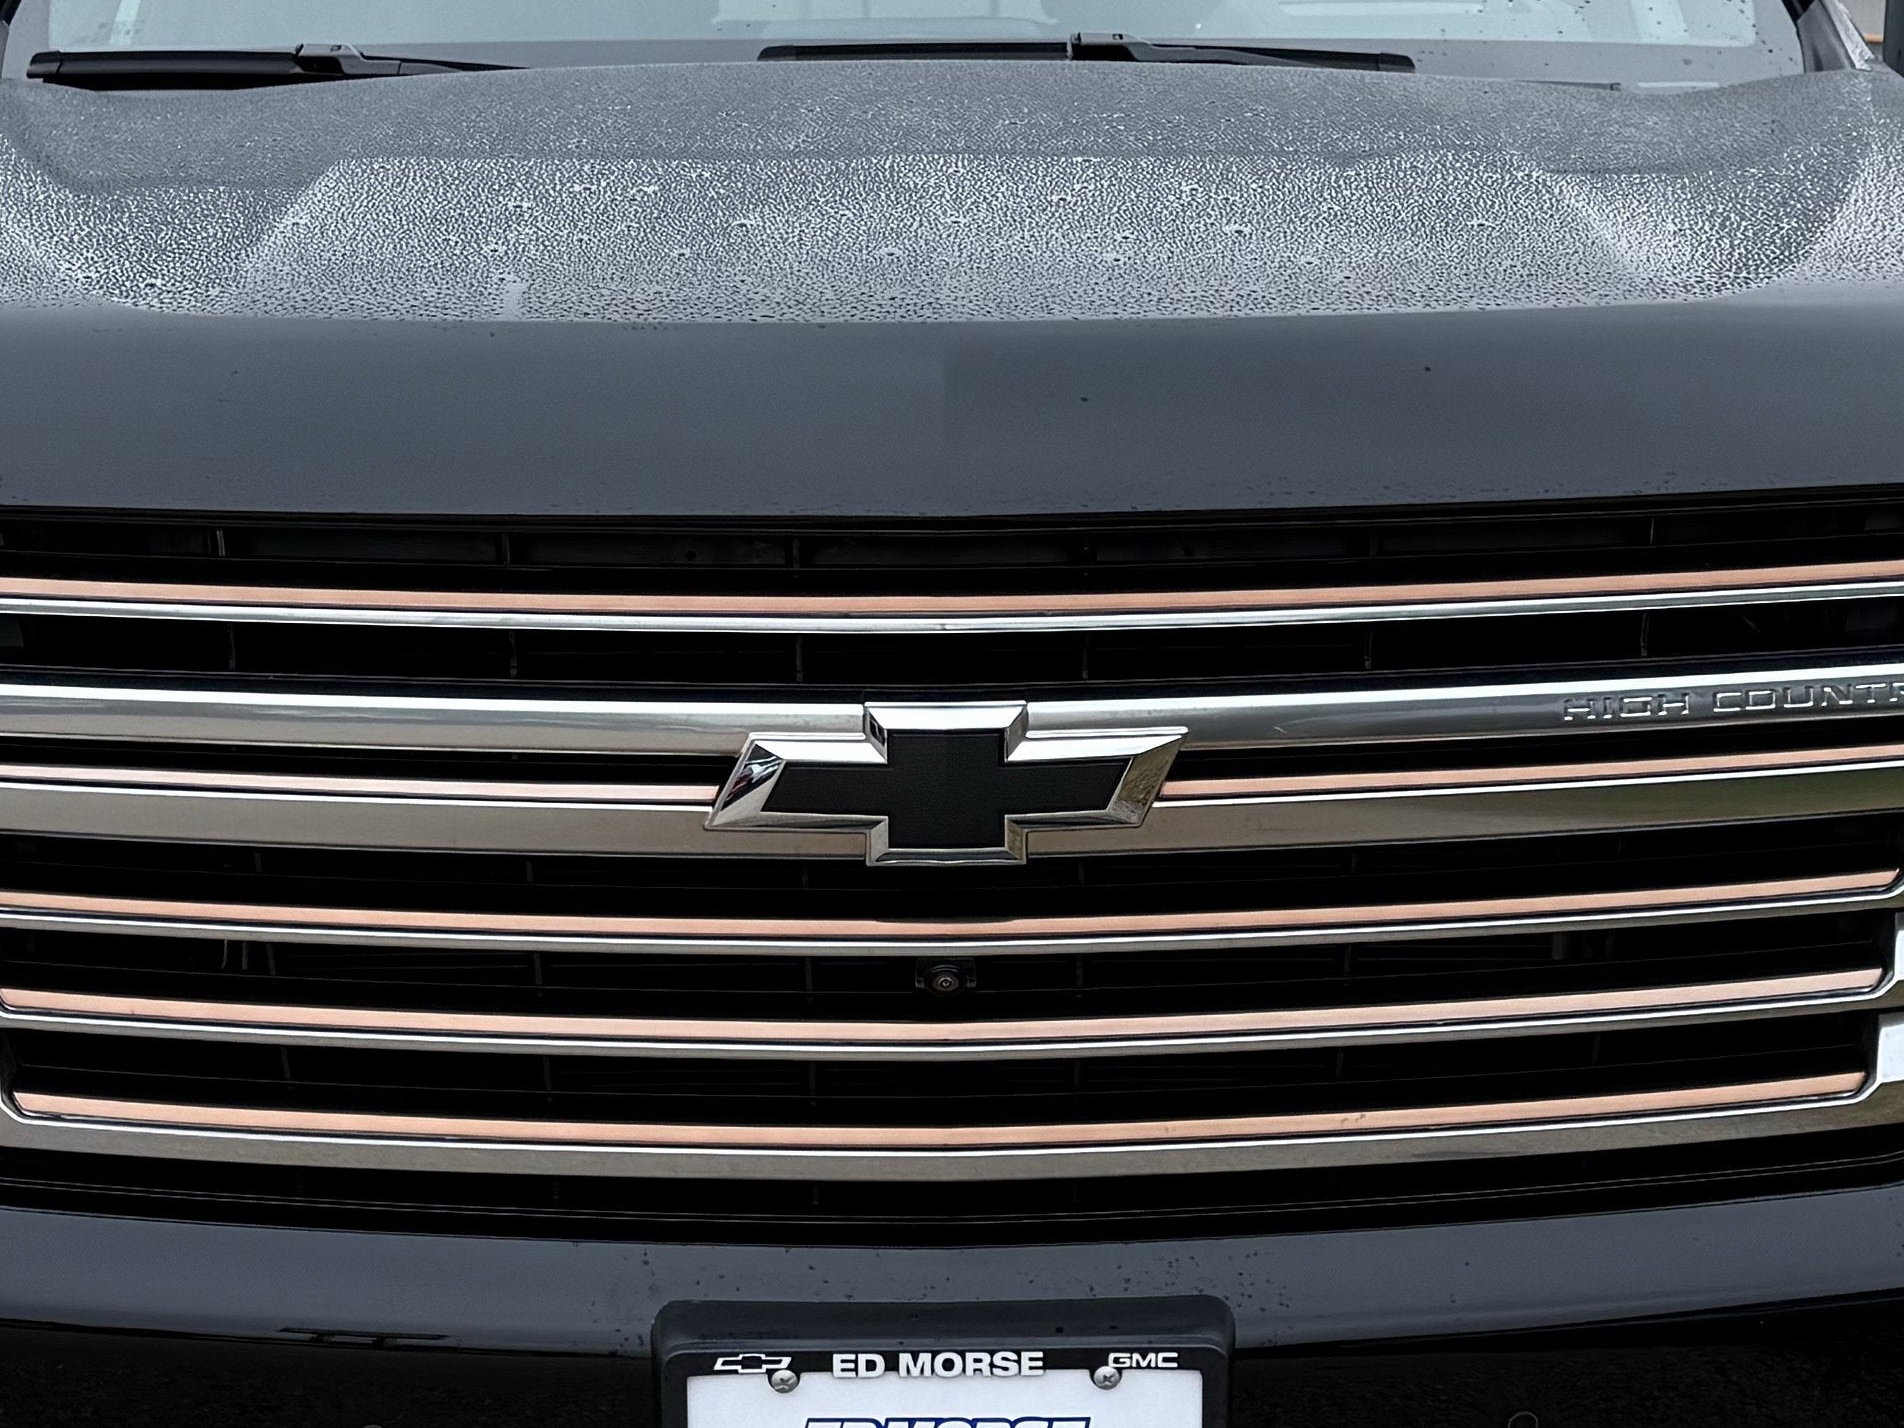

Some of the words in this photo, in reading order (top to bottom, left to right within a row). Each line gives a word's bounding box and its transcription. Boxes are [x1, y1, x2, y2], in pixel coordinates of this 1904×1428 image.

[1563, 692, 1690, 721] HIGH
[832, 1353, 886, 1378] ED
[898, 1351, 1045, 1378] MORSE
[1108, 1352, 1179, 1368] GMC
